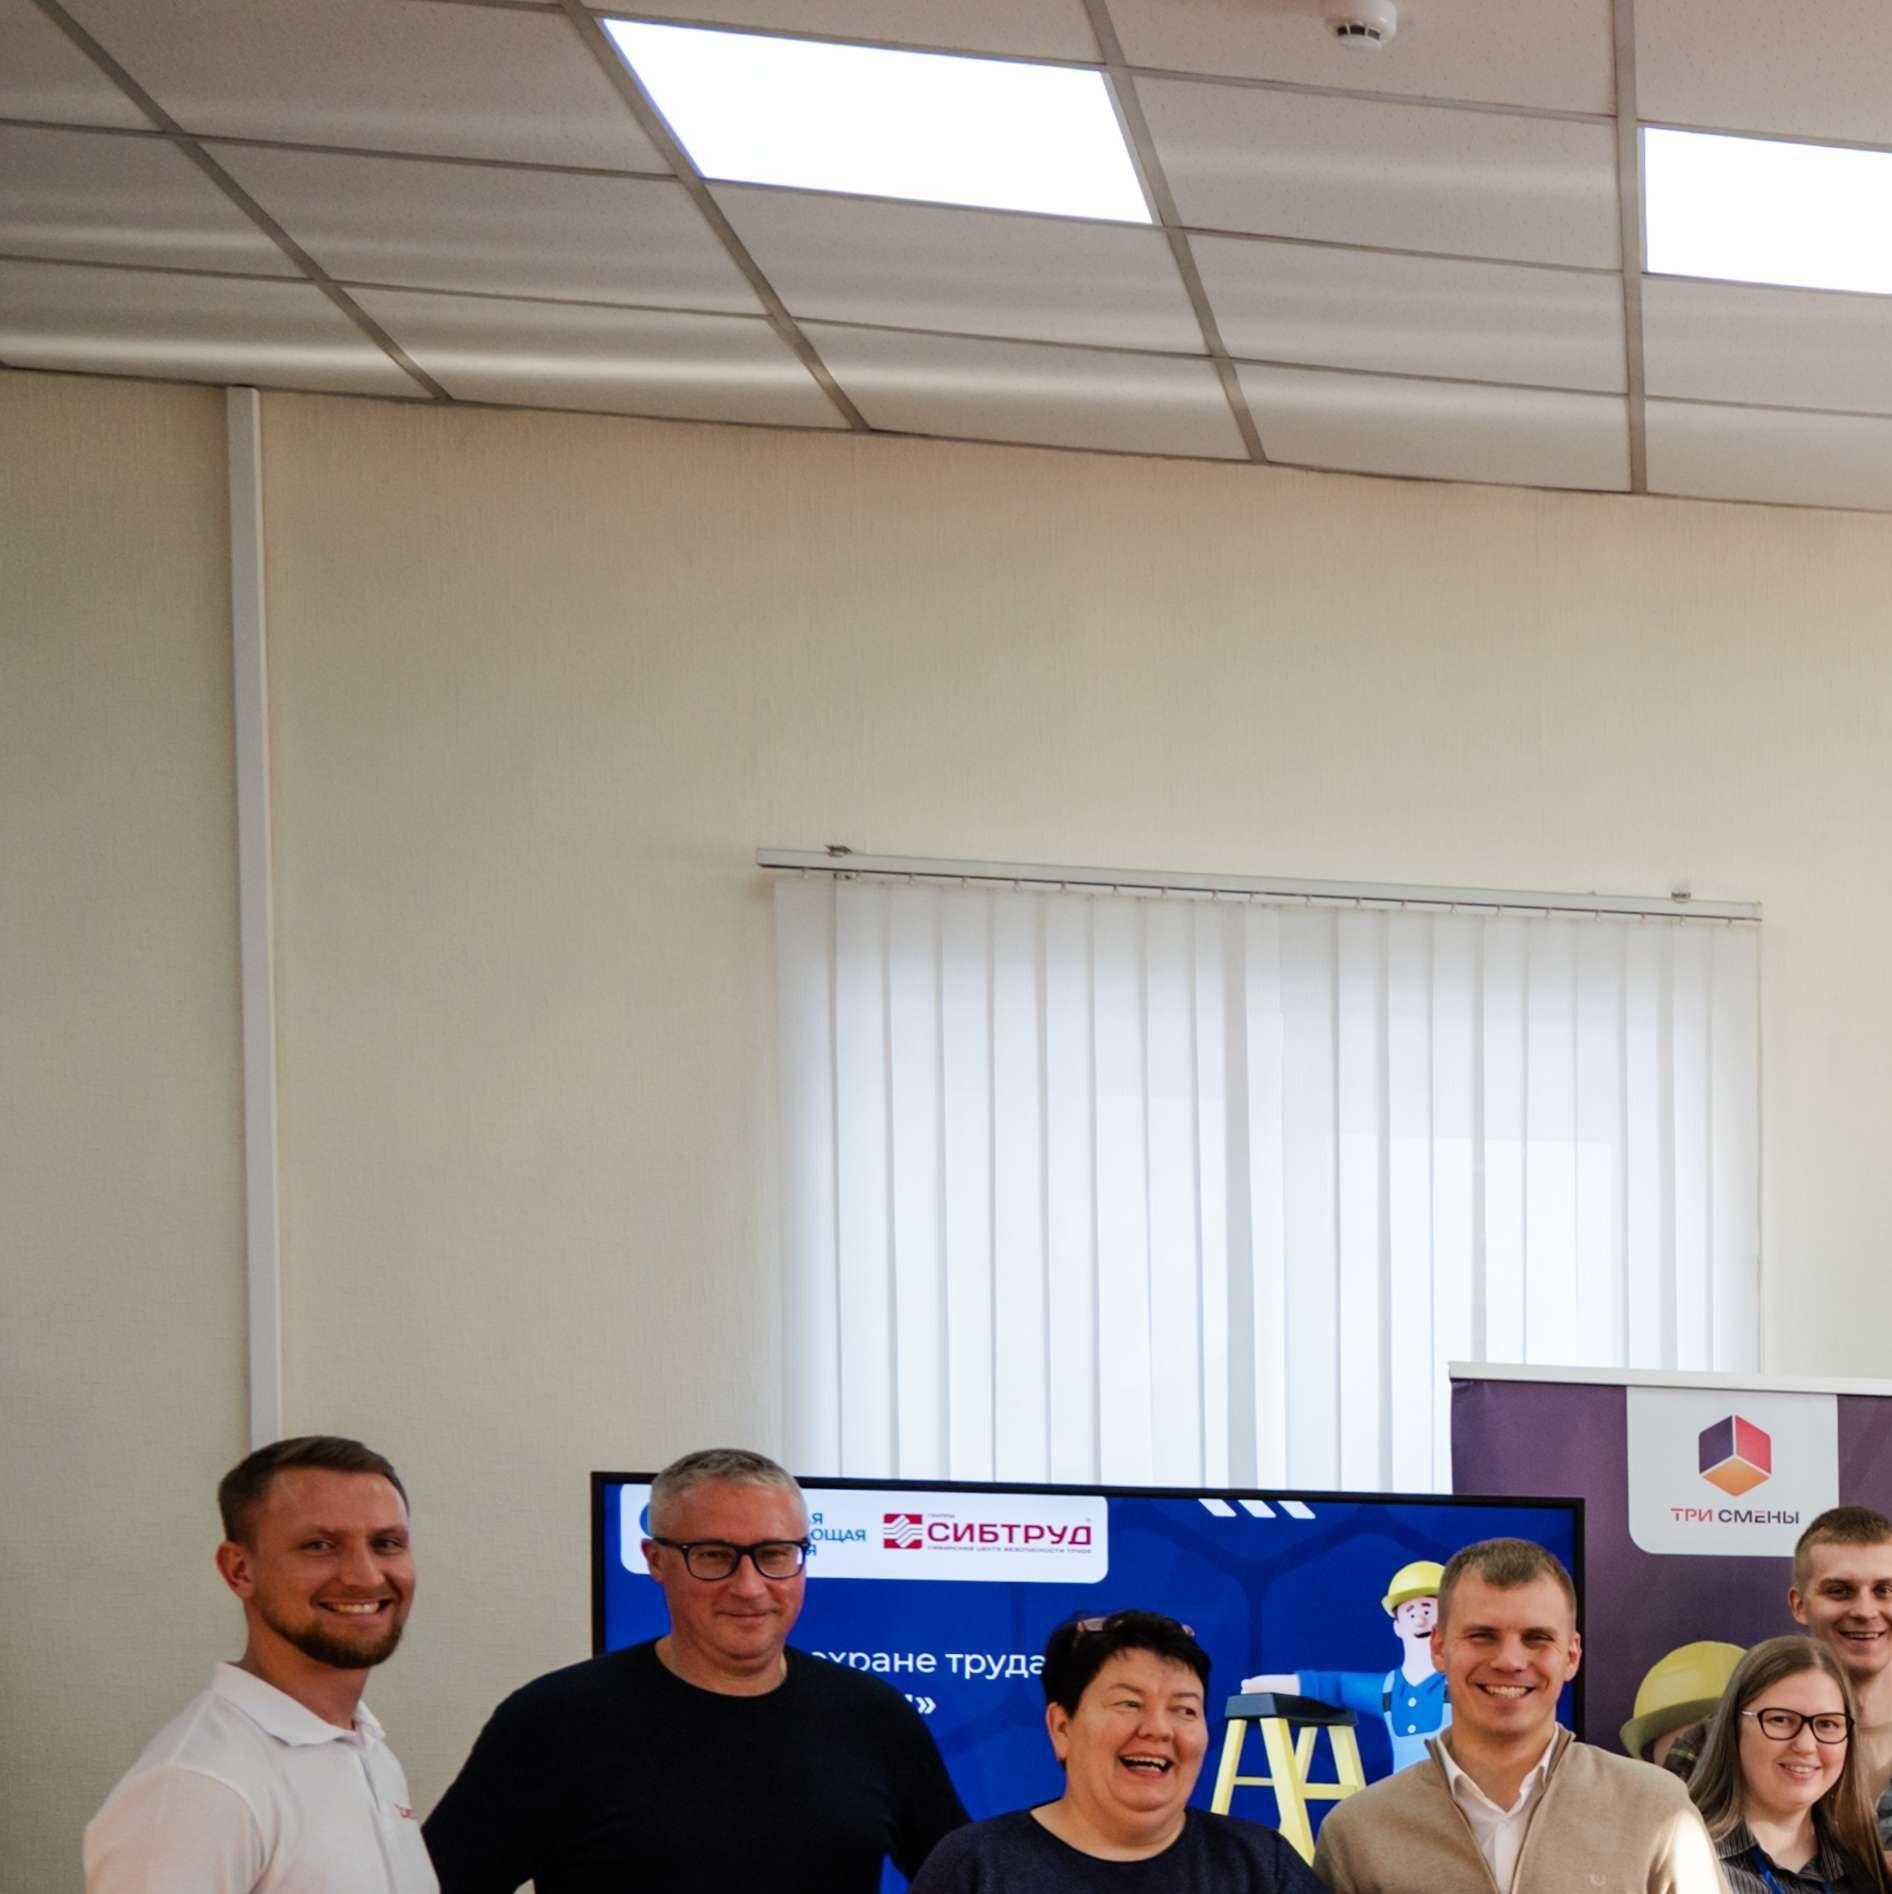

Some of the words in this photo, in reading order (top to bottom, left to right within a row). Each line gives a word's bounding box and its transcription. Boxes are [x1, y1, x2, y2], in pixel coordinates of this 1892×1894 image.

[1670, 1507, 1713, 1523] ТРИ
[1718, 1508, 1799, 1525] СМЕНЫ
[927, 1522, 1091, 1545] СИБТРУД
[945, 1653, 1046, 1680] труда
